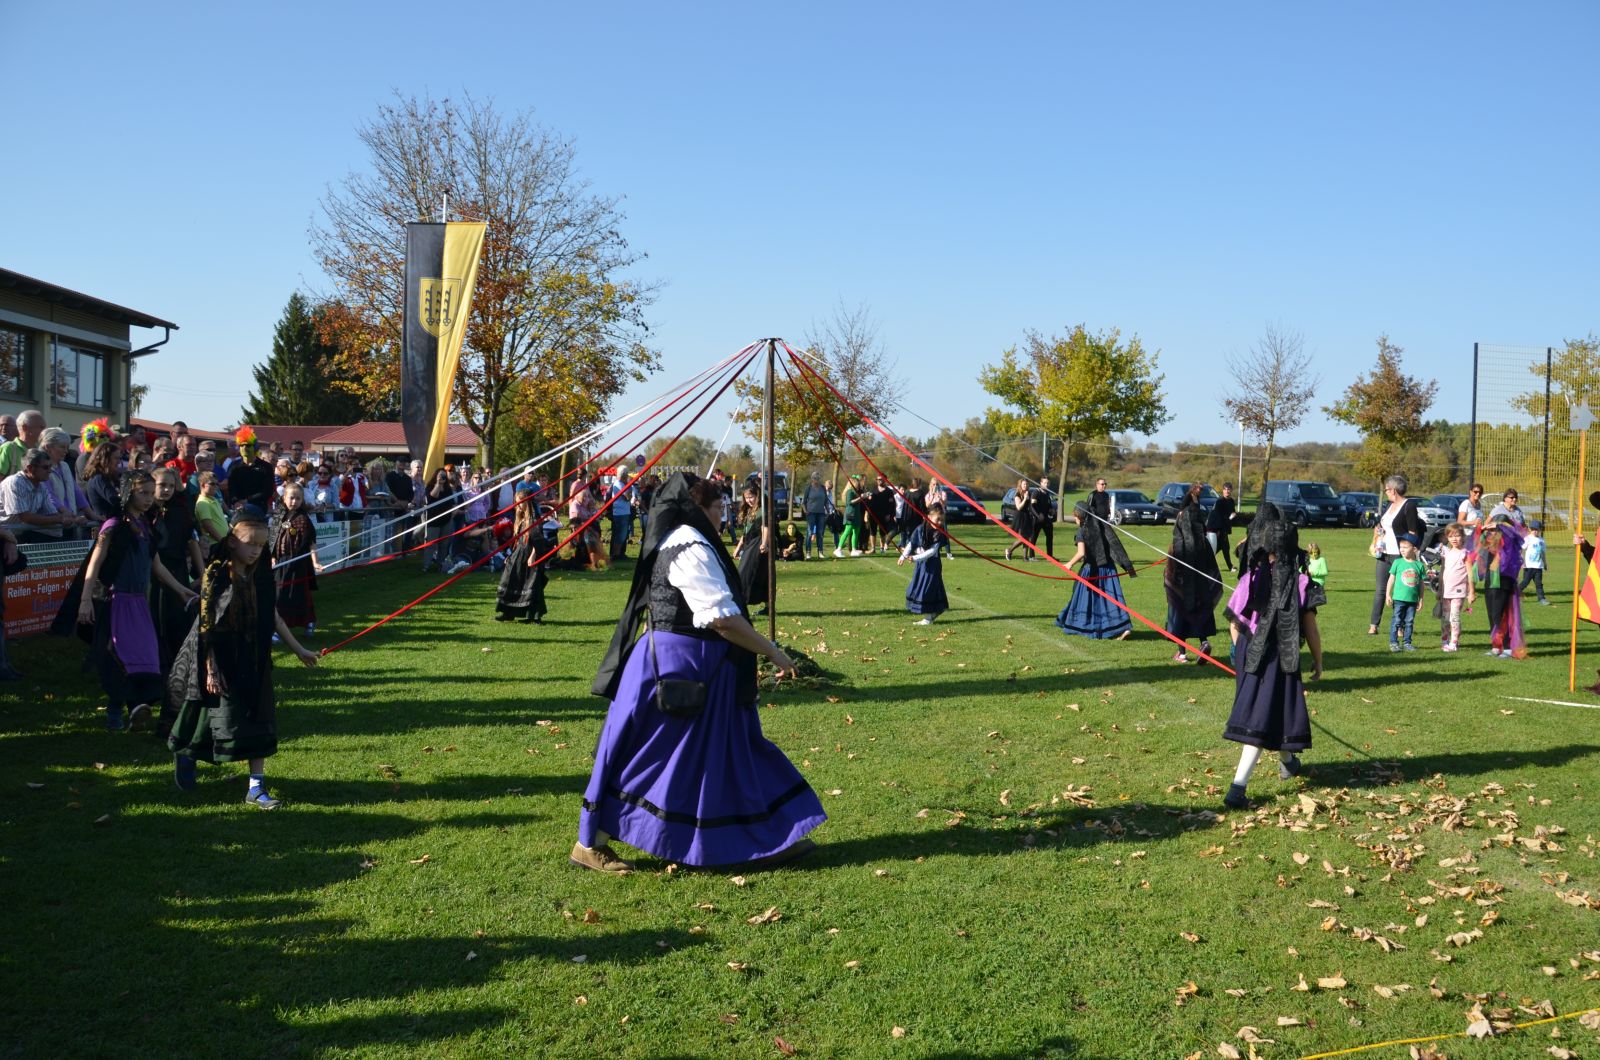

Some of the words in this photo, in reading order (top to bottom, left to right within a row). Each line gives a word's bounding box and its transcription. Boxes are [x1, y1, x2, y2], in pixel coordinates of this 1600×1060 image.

[31, 569, 48, 580] kauft
[50, 570, 64, 578] man
[8, 587, 31, 598] Reifen
[37, 584, 60, 594] Felgen
